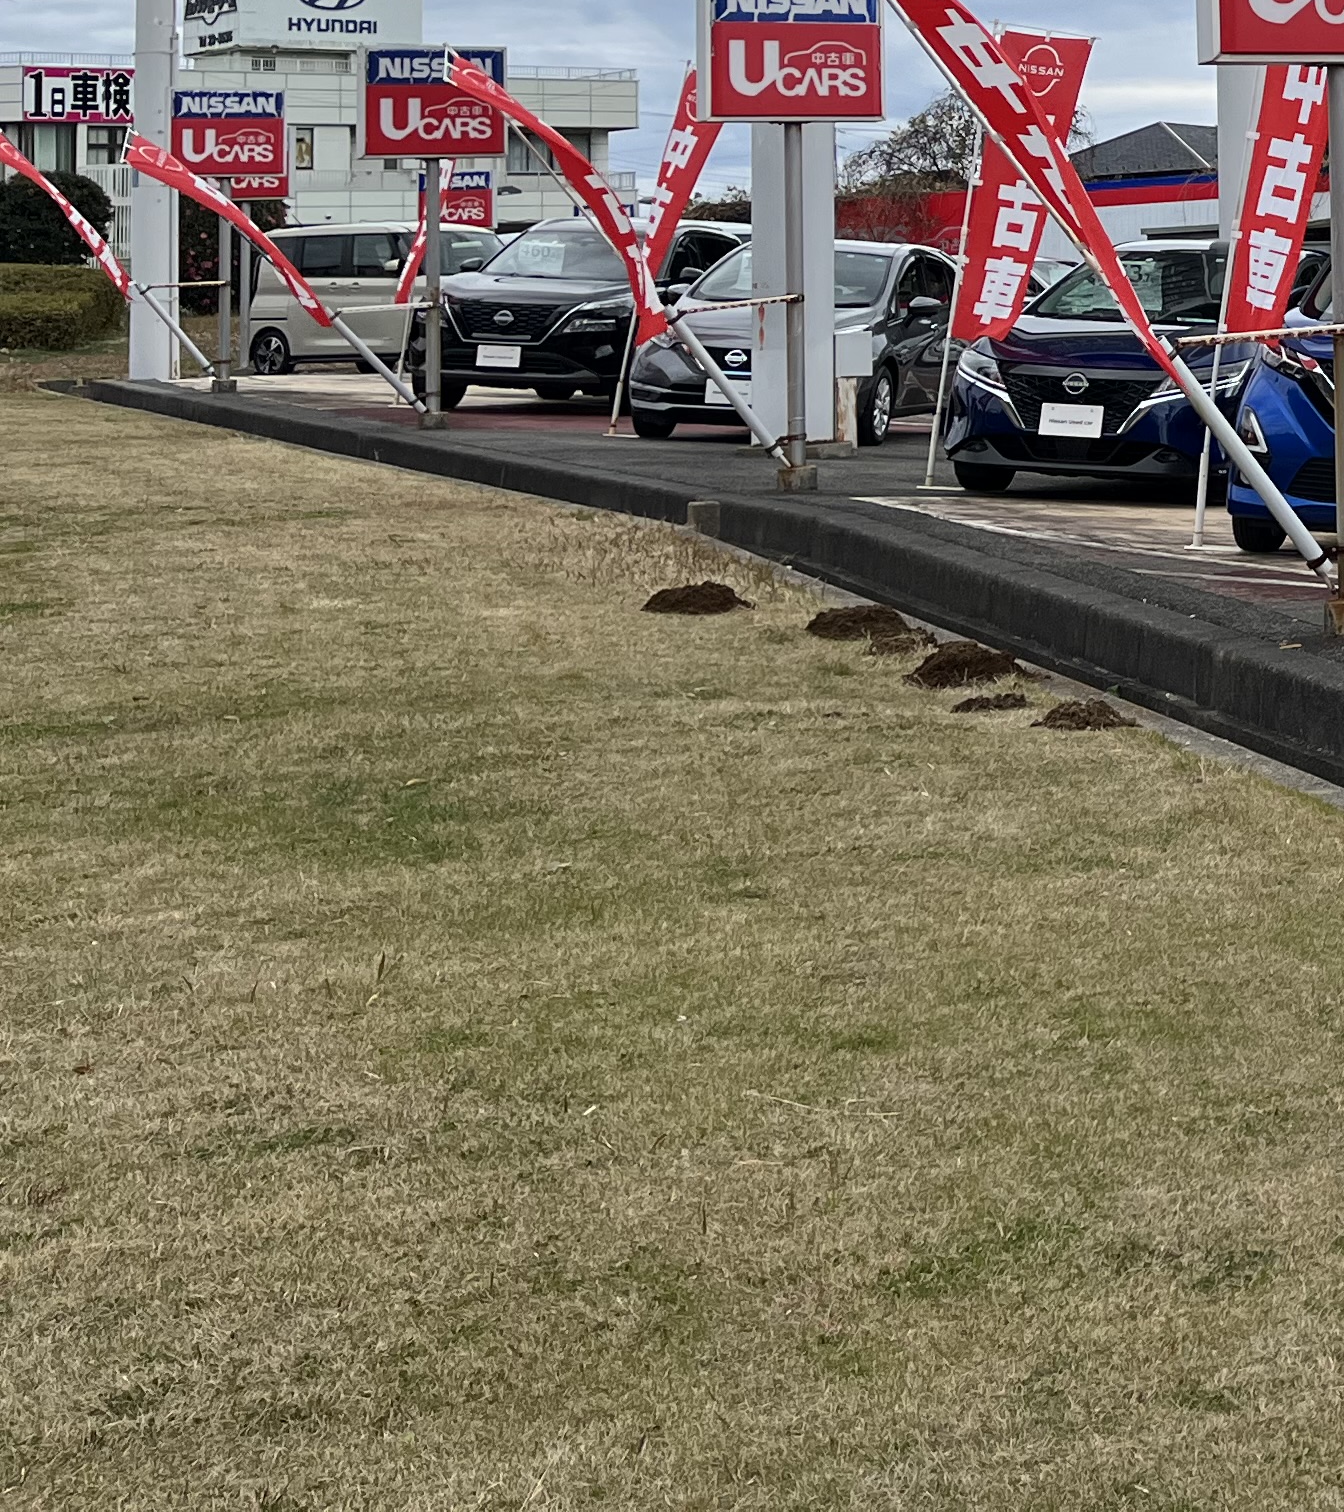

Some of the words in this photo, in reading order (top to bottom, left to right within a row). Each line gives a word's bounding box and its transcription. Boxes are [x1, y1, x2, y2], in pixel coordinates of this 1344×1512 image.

[288, 17, 378, 35] HYUNDAI
[811, 51, 856, 66] 中古車
[379, 57, 493, 80] NISSN
[1018, 61, 1065, 79] NISSAN
[27, 71, 131, 118] 1日車検
[180, 96, 276, 114] NISSAN
